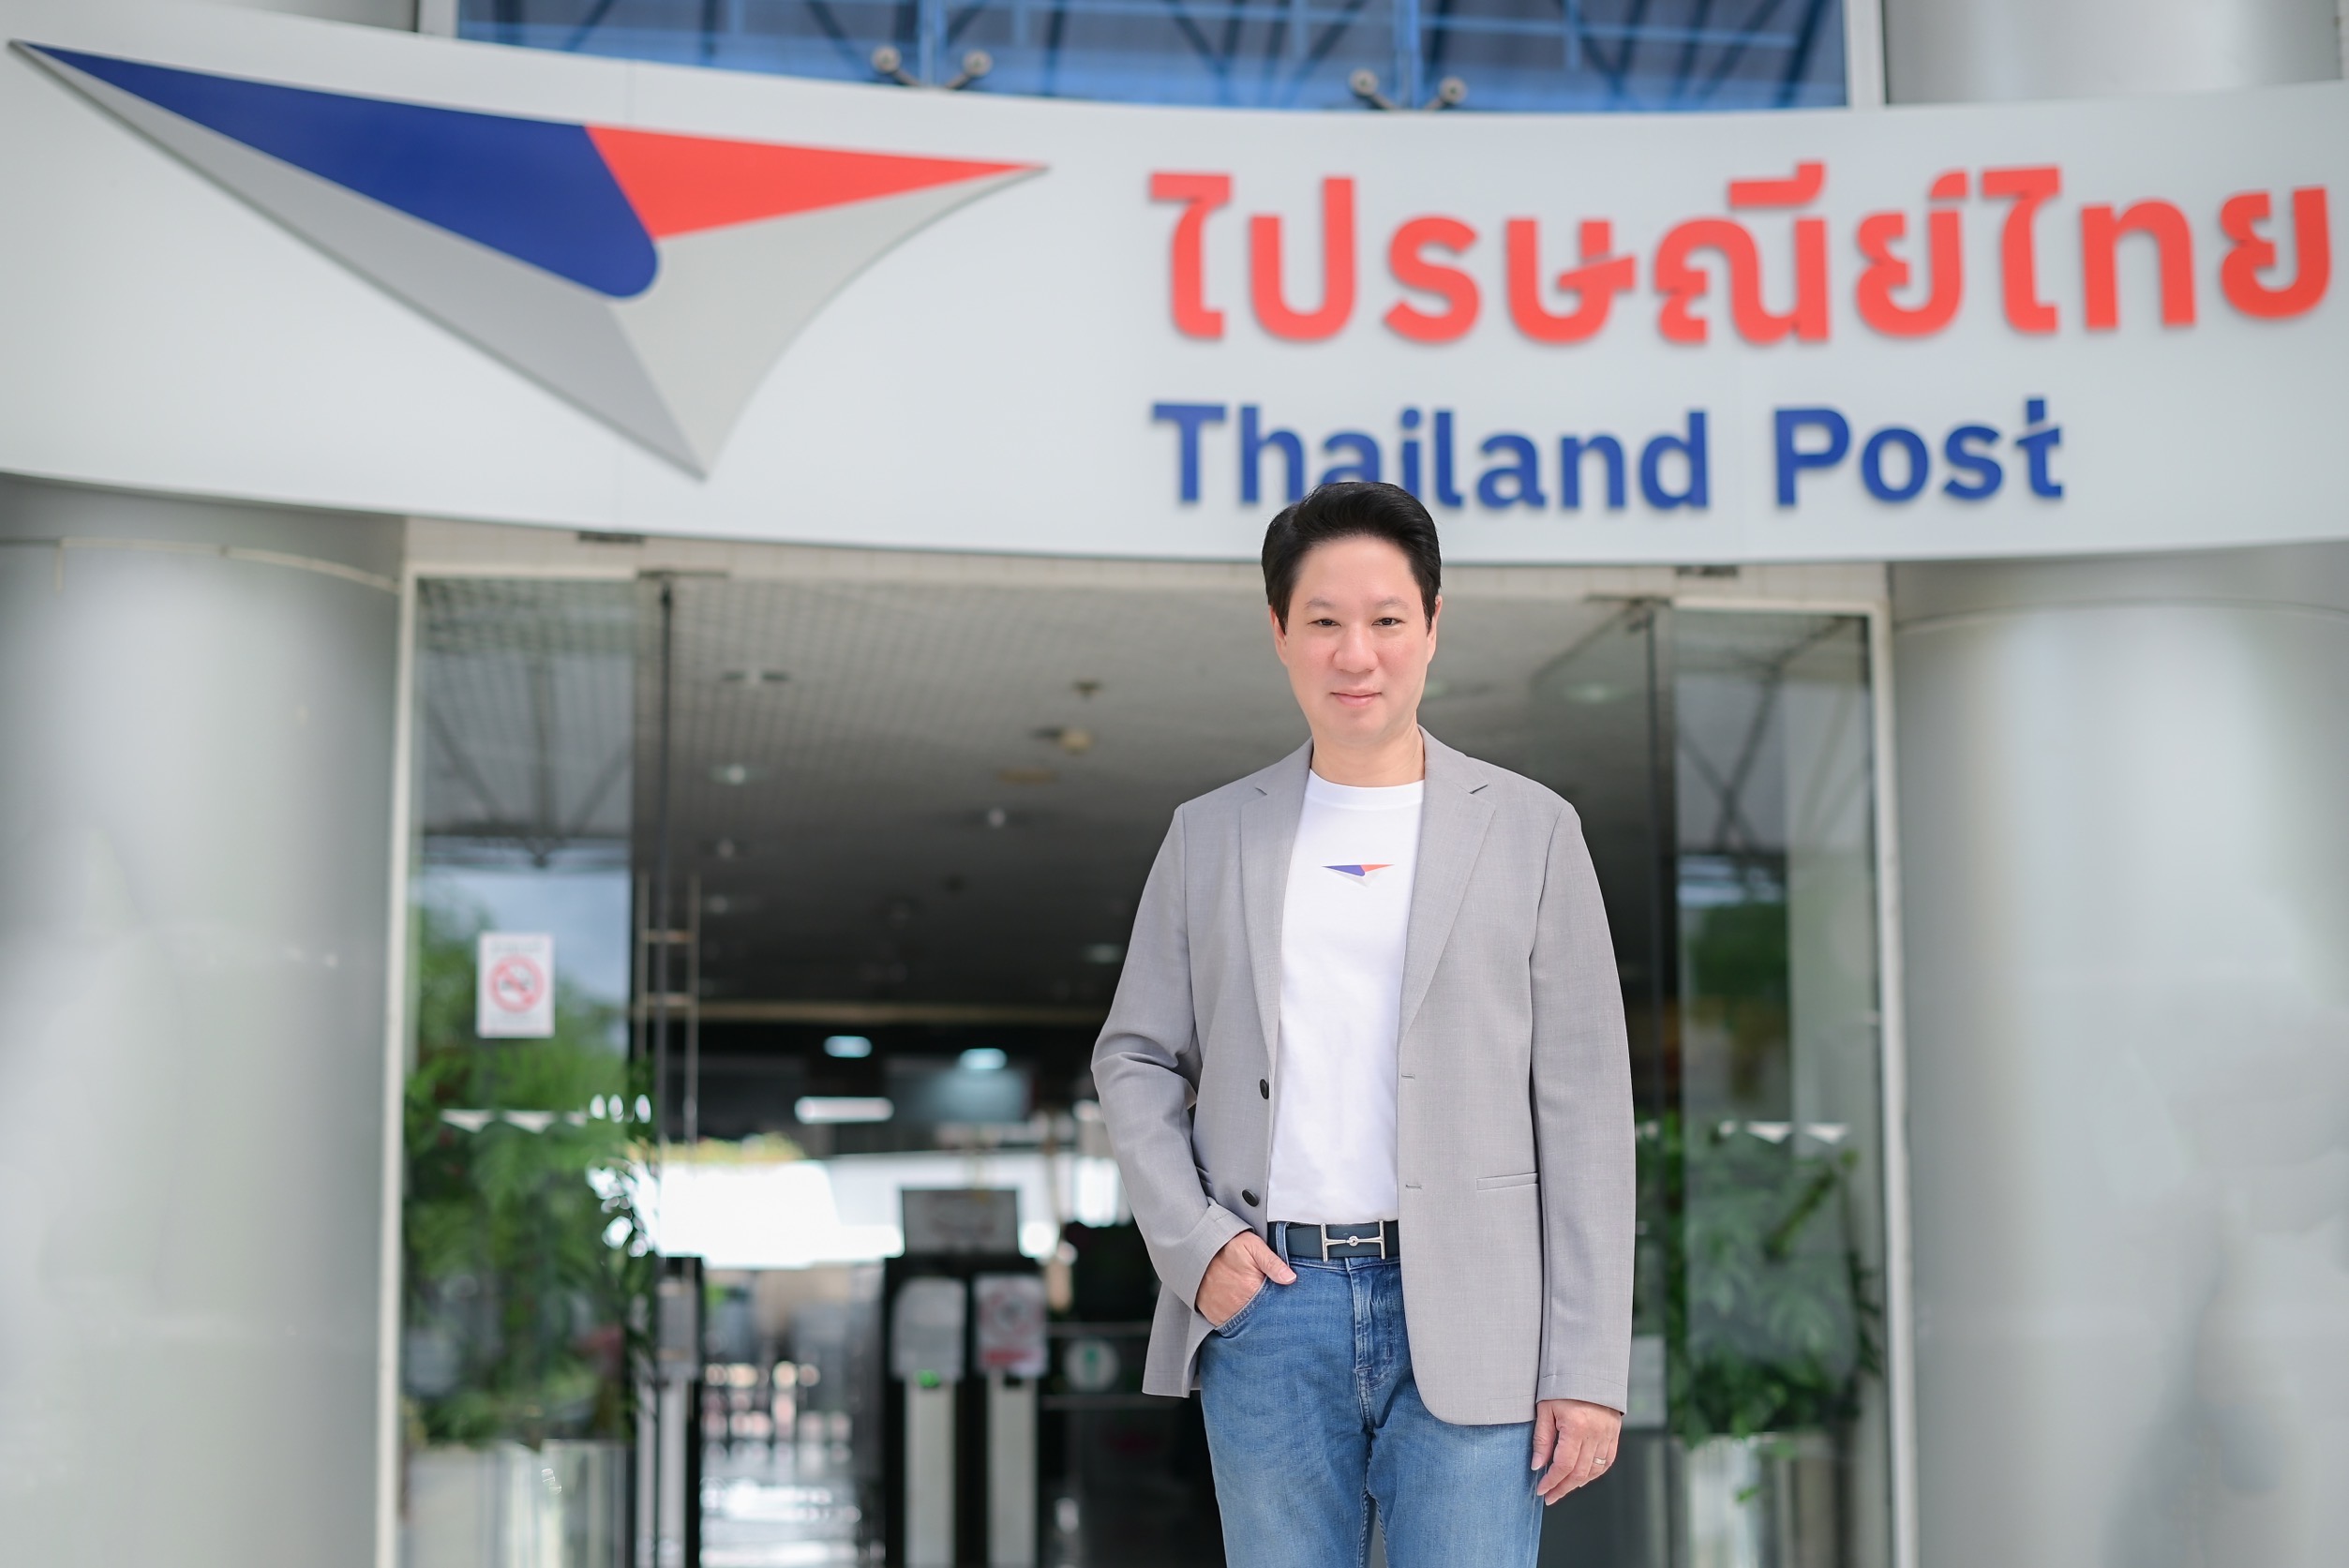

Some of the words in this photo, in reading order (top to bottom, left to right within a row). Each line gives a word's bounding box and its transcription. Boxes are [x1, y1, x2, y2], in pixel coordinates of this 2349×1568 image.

[1149, 160, 2333, 347] ไปรษณีย์ไทย
[1152, 401, 1711, 511] Thailand
[1773, 396, 2065, 507] Post
